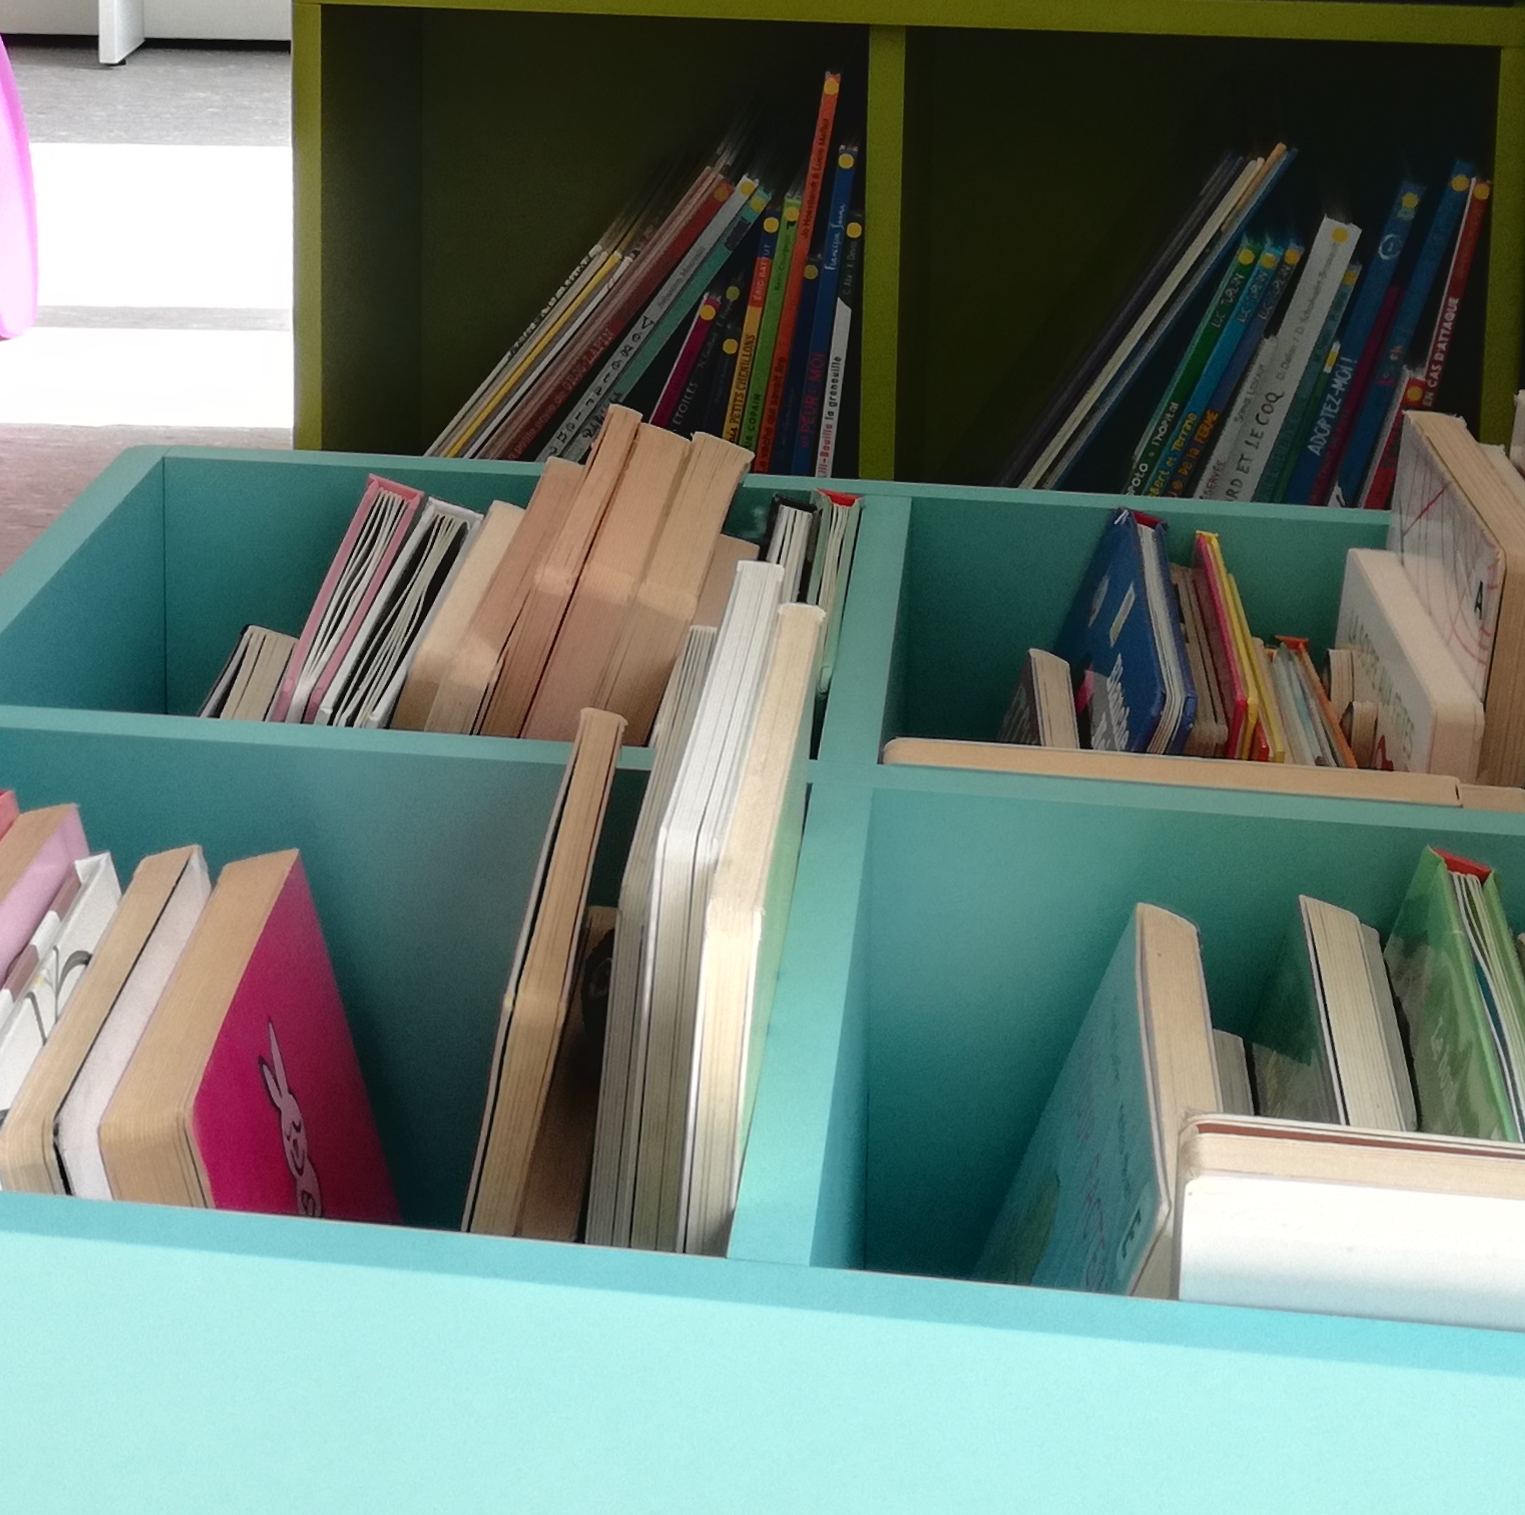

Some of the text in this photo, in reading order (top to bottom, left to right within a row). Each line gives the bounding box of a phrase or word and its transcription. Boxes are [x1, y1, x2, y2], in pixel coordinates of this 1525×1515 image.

[1434, 296, 1460, 361] D'ATTAQUE
[808, 351, 825, 383] MOI
[826, 356, 843, 407] grenouille
[1426, 361, 1443, 390] CAS
[729, 391, 745, 425] PETITS
[746, 393, 761, 432] COPAIN
[765, 407, 777, 425] qui
[799, 394, 820, 434] PEUR
[825, 411, 834, 420] la
[1194, 408, 1220, 445] FERME
[1307, 366, 1353, 457] ADOPTEZ-MOI
[759, 427, 773, 459] vache
[1237, 456, 1253, 478] ET
[1245, 429, 1264, 454] LE
[1256, 391, 1285, 427] COQ
